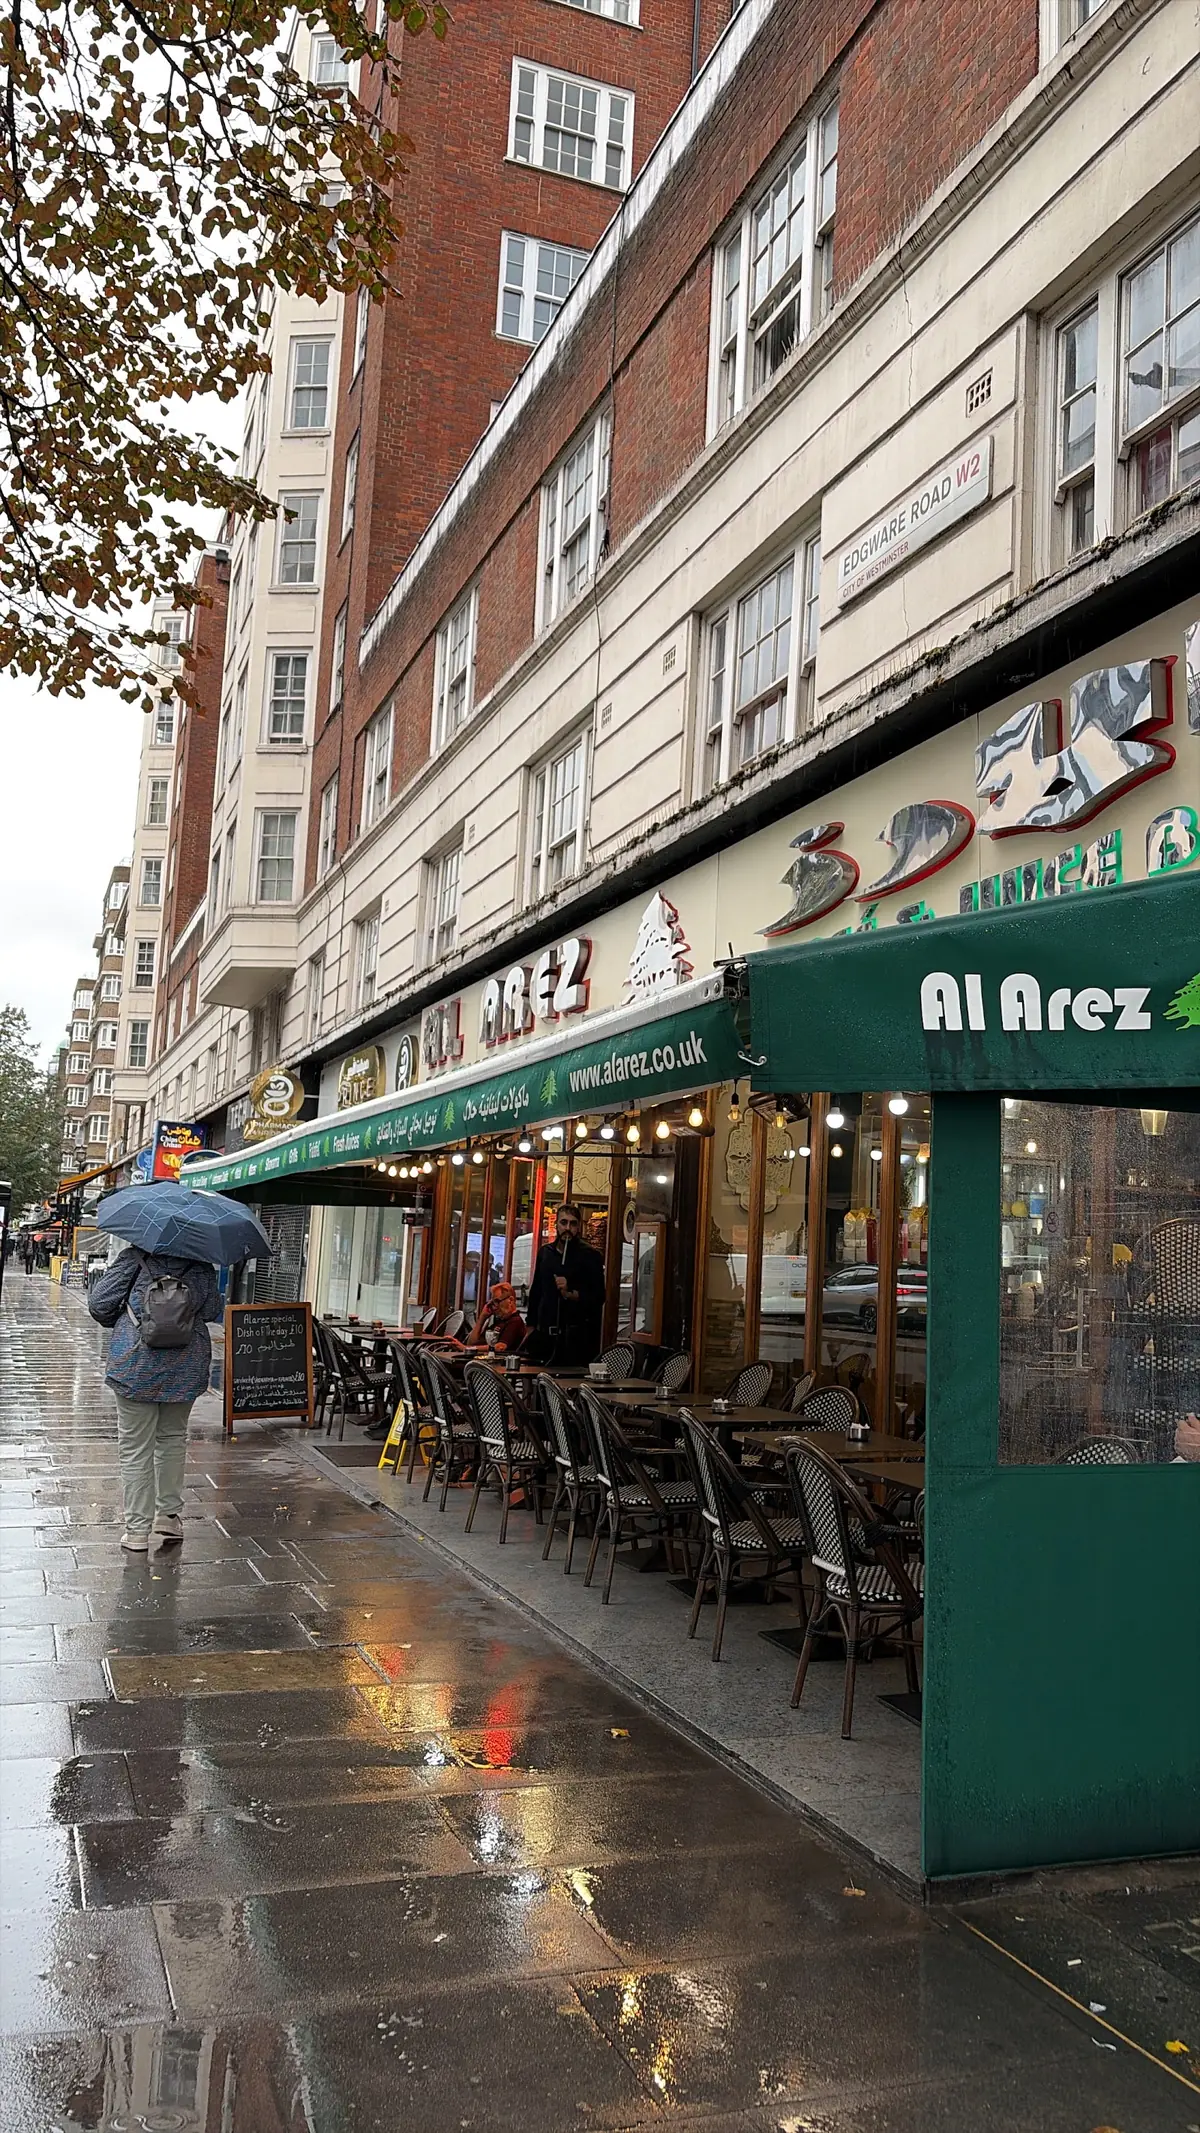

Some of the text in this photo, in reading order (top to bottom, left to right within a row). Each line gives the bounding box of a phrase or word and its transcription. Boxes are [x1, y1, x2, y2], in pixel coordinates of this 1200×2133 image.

[843, 453, 981, 577] EDGWARE ROAD W2
[842, 541, 909, 598] CITY OF WESTMINSTER
[421, 936, 592, 1068] AL AREZ
[920, 971, 1151, 1031] Al Arez
[569, 1030, 707, 1093] www.alarez.co.uk
[254, 1121, 297, 1131] PHARMACY
[237, 1327, 254, 1338] Dish
[276, 1325, 288, 1338] day
[289, 1323, 304, 1335] £10
